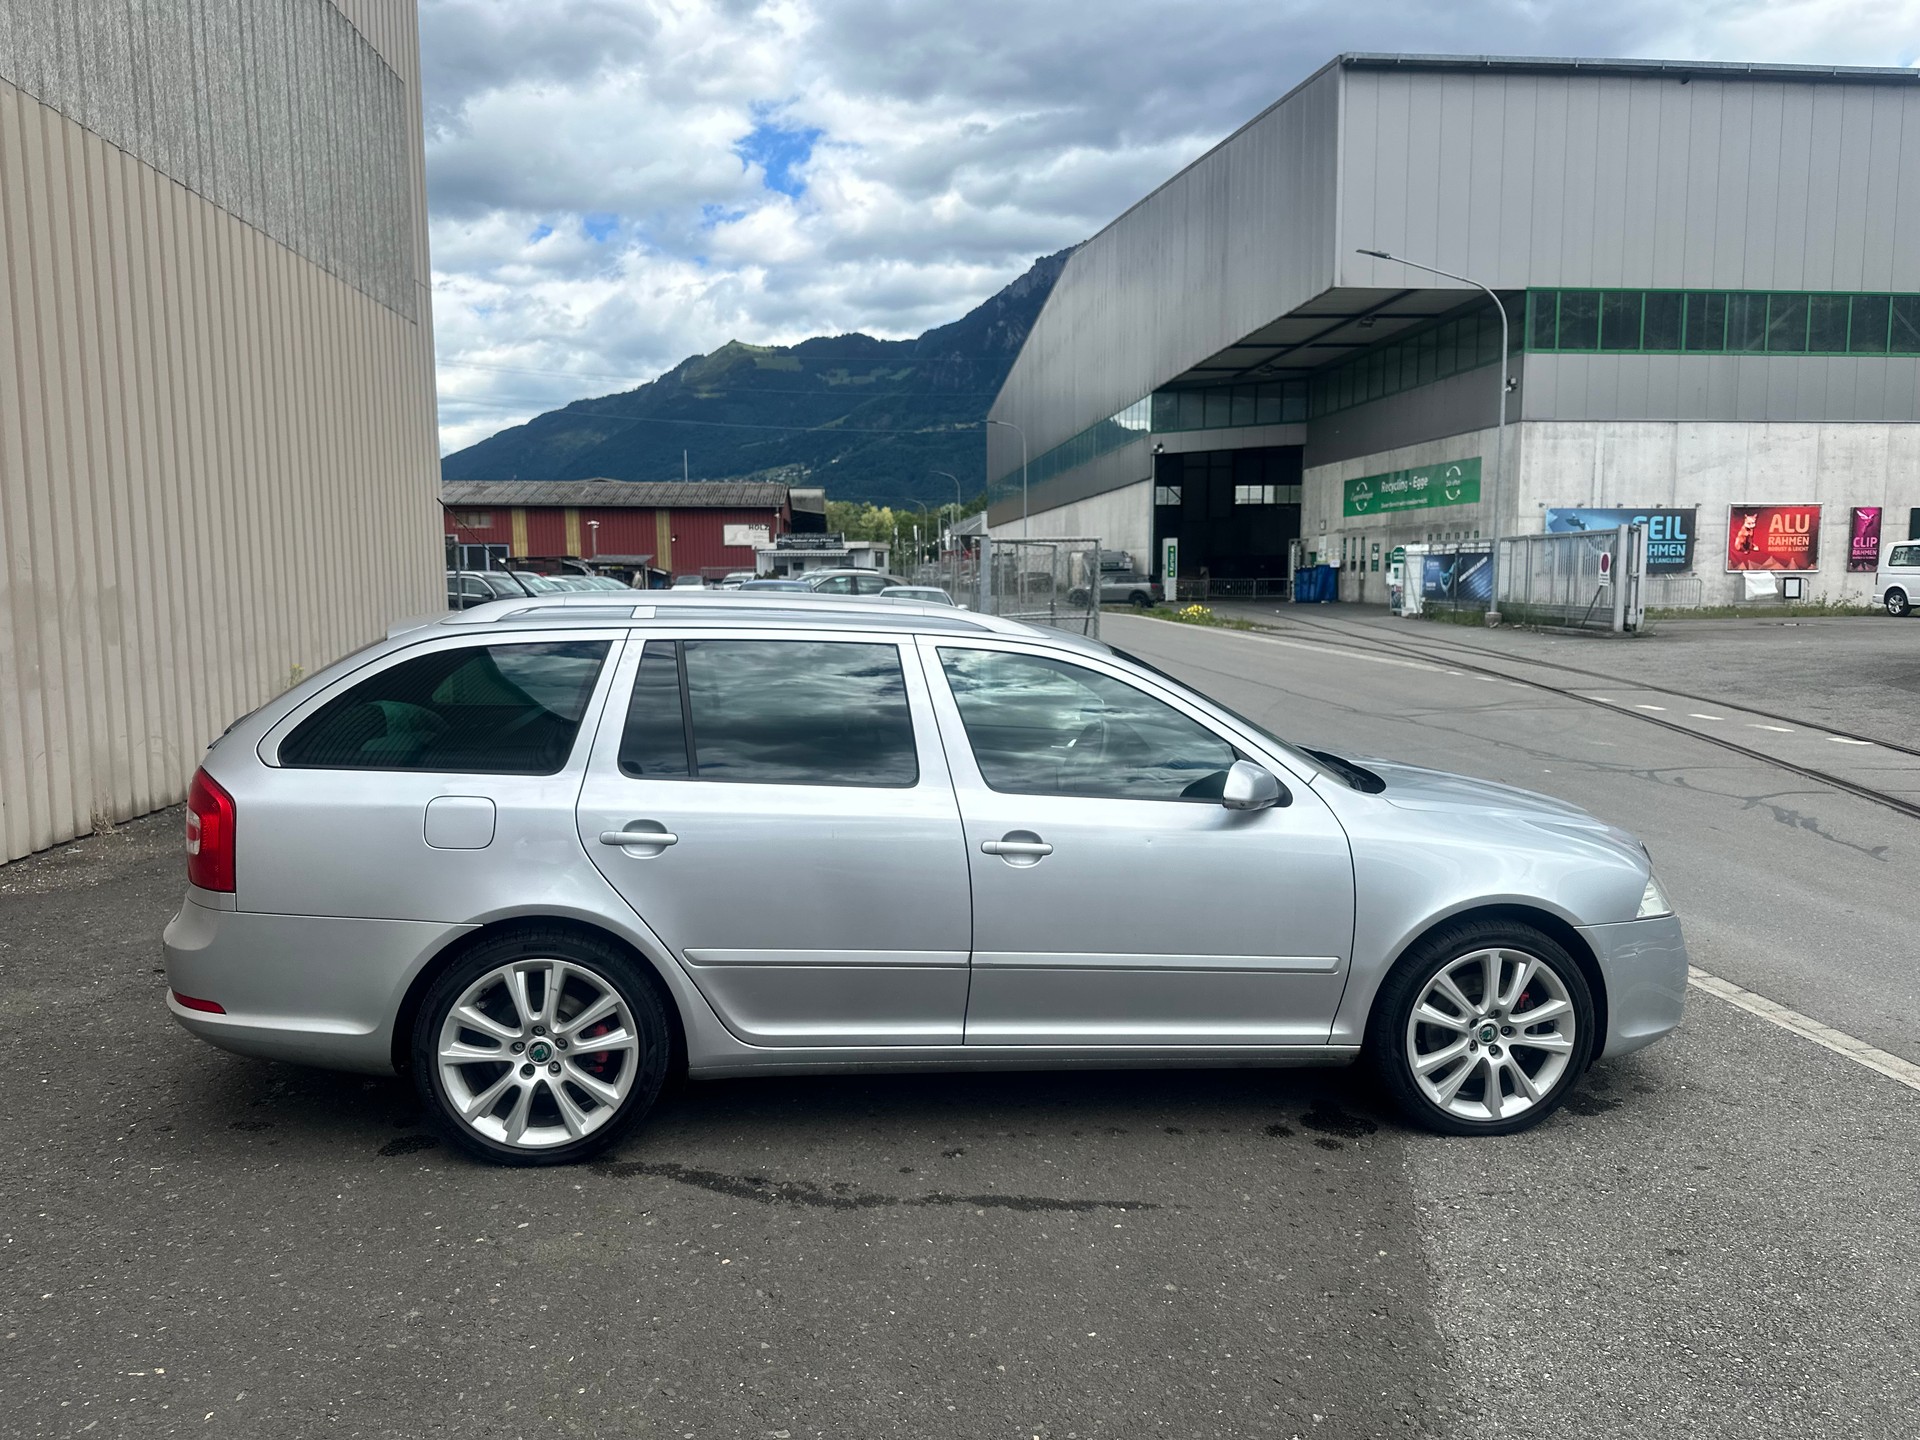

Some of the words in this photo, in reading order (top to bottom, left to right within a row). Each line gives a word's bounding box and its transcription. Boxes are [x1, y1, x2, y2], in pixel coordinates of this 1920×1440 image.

[1381, 478, 1408, 494] Recycling
[1413, 475, 1428, 490] Egge
[1769, 514, 1810, 533] ALU
[1768, 536, 1810, 546] RAHMEN
[1853, 536, 1878, 548] CLIP
[1648, 544, 1686, 556] HMEN
